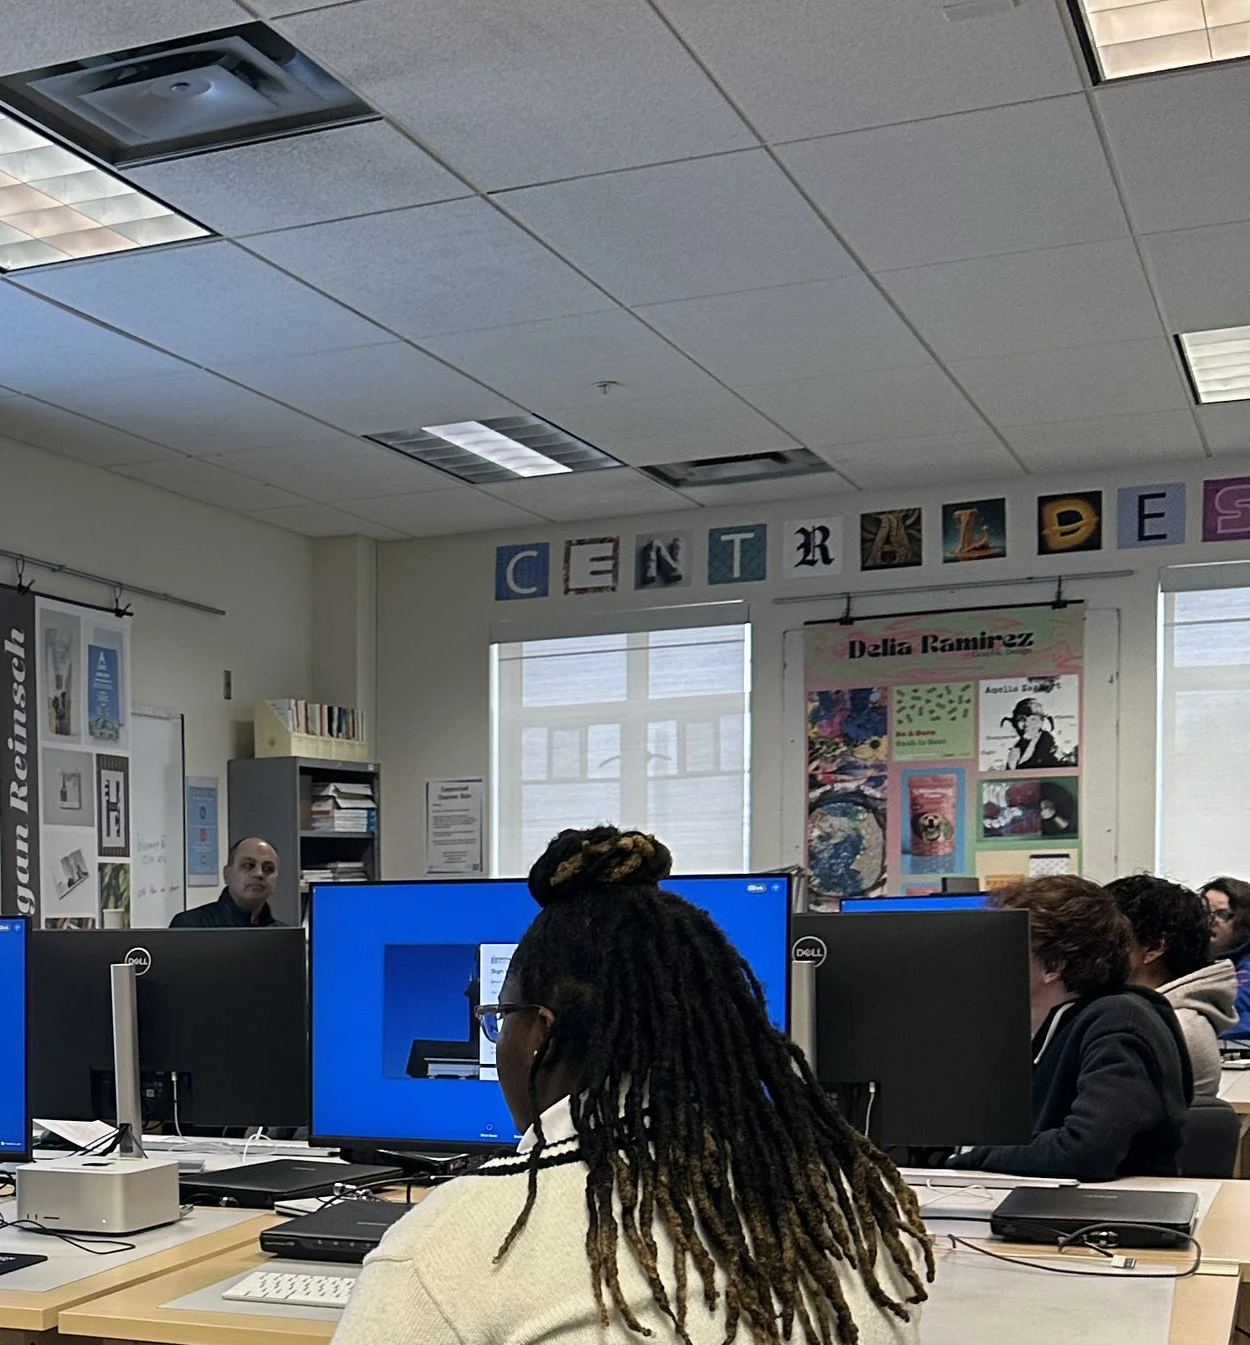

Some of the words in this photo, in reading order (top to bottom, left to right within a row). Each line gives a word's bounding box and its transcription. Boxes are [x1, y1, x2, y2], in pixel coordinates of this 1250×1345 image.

[849, 638, 912, 659] Delia
[921, 631, 1034, 655] Ramirez
[4, 627, 30, 815] Reinsch
[14, 822, 36, 916] gan
[796, 948, 822, 957] DELL
